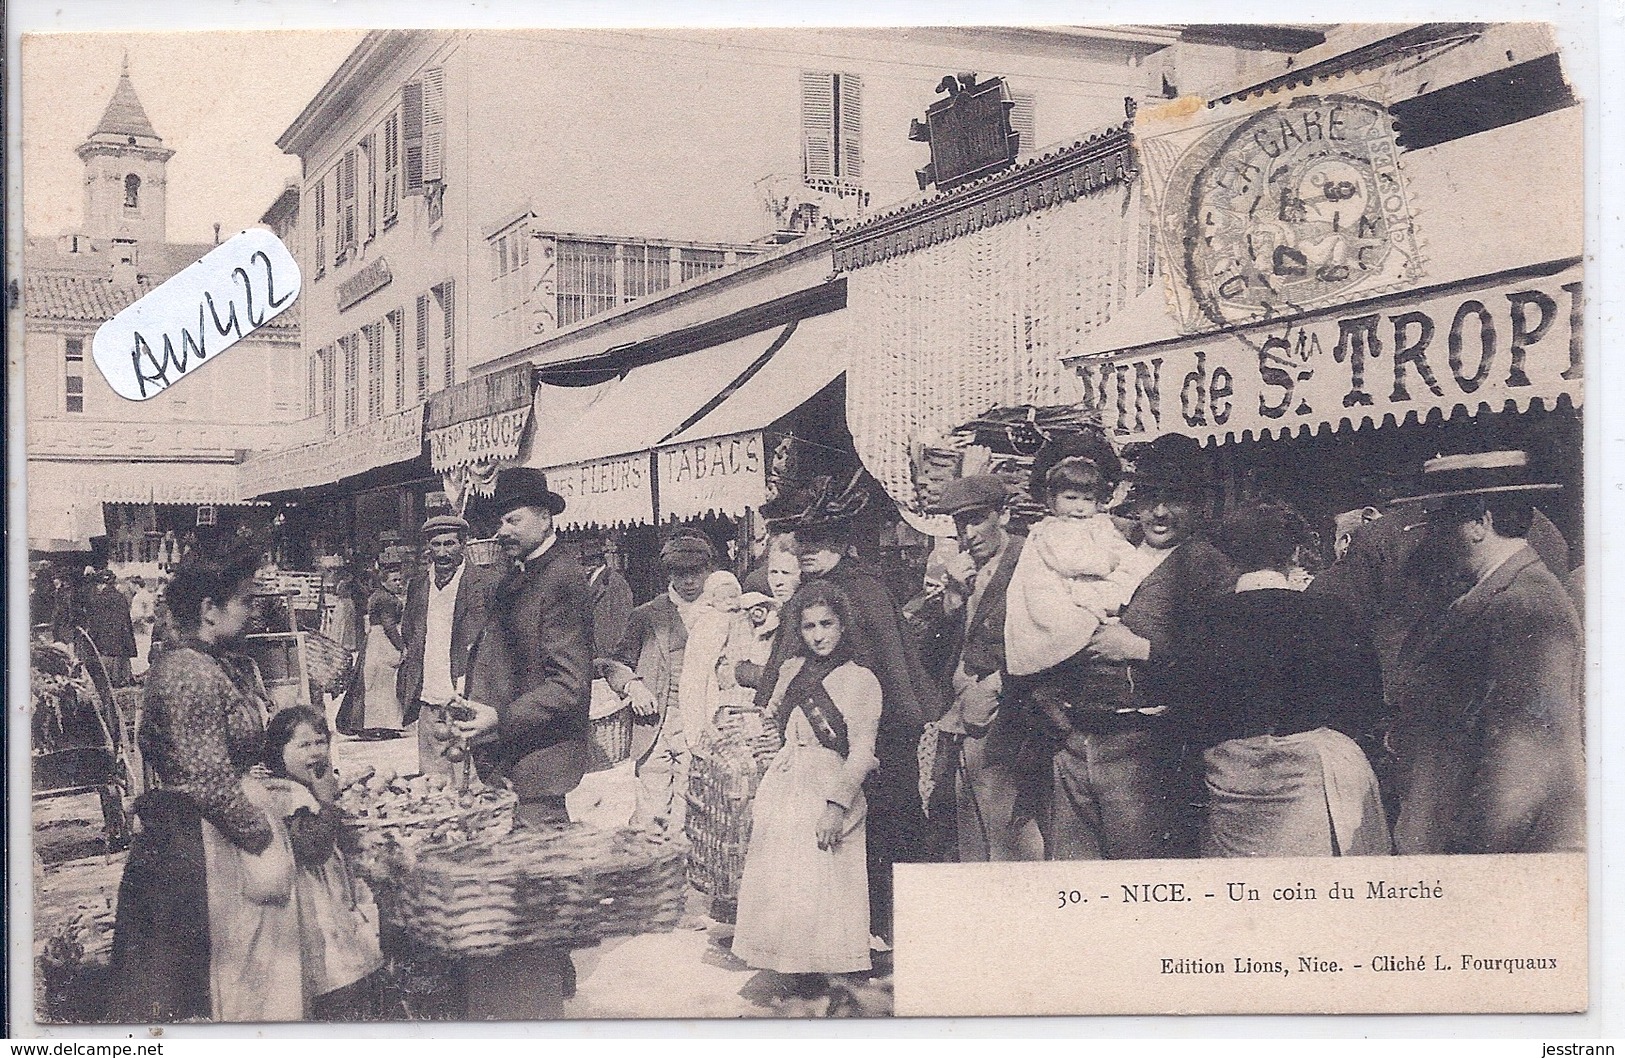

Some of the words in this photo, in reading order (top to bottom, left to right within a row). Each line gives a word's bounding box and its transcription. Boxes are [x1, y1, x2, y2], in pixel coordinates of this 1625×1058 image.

[1254, 106, 1344, 159] GARE
[1076, 356, 1163, 436] VIN
[1180, 351, 1233, 429] de
[467, 411, 523, 452] BROCH
[664, 437, 760, 485] TABACS
[1057, 889, 1088, 909] 30.
[1120, 883, 1192, 903] NICE.
[1226, 882, 1261, 902] Un
[1272, 882, 1317, 901] coin
[1328, 881, 1355, 900] du
[1366, 879, 1443, 900] Marché
[1160, 958, 1225, 974] Edition
[1234, 957, 1289, 978] Lions,
[1298, 956, 1344, 973] Nice.
[1371, 955, 1426, 972] Cliché
[1434, 954, 1452, 971] L.
[1461, 954, 1557, 974] Fourquaux
